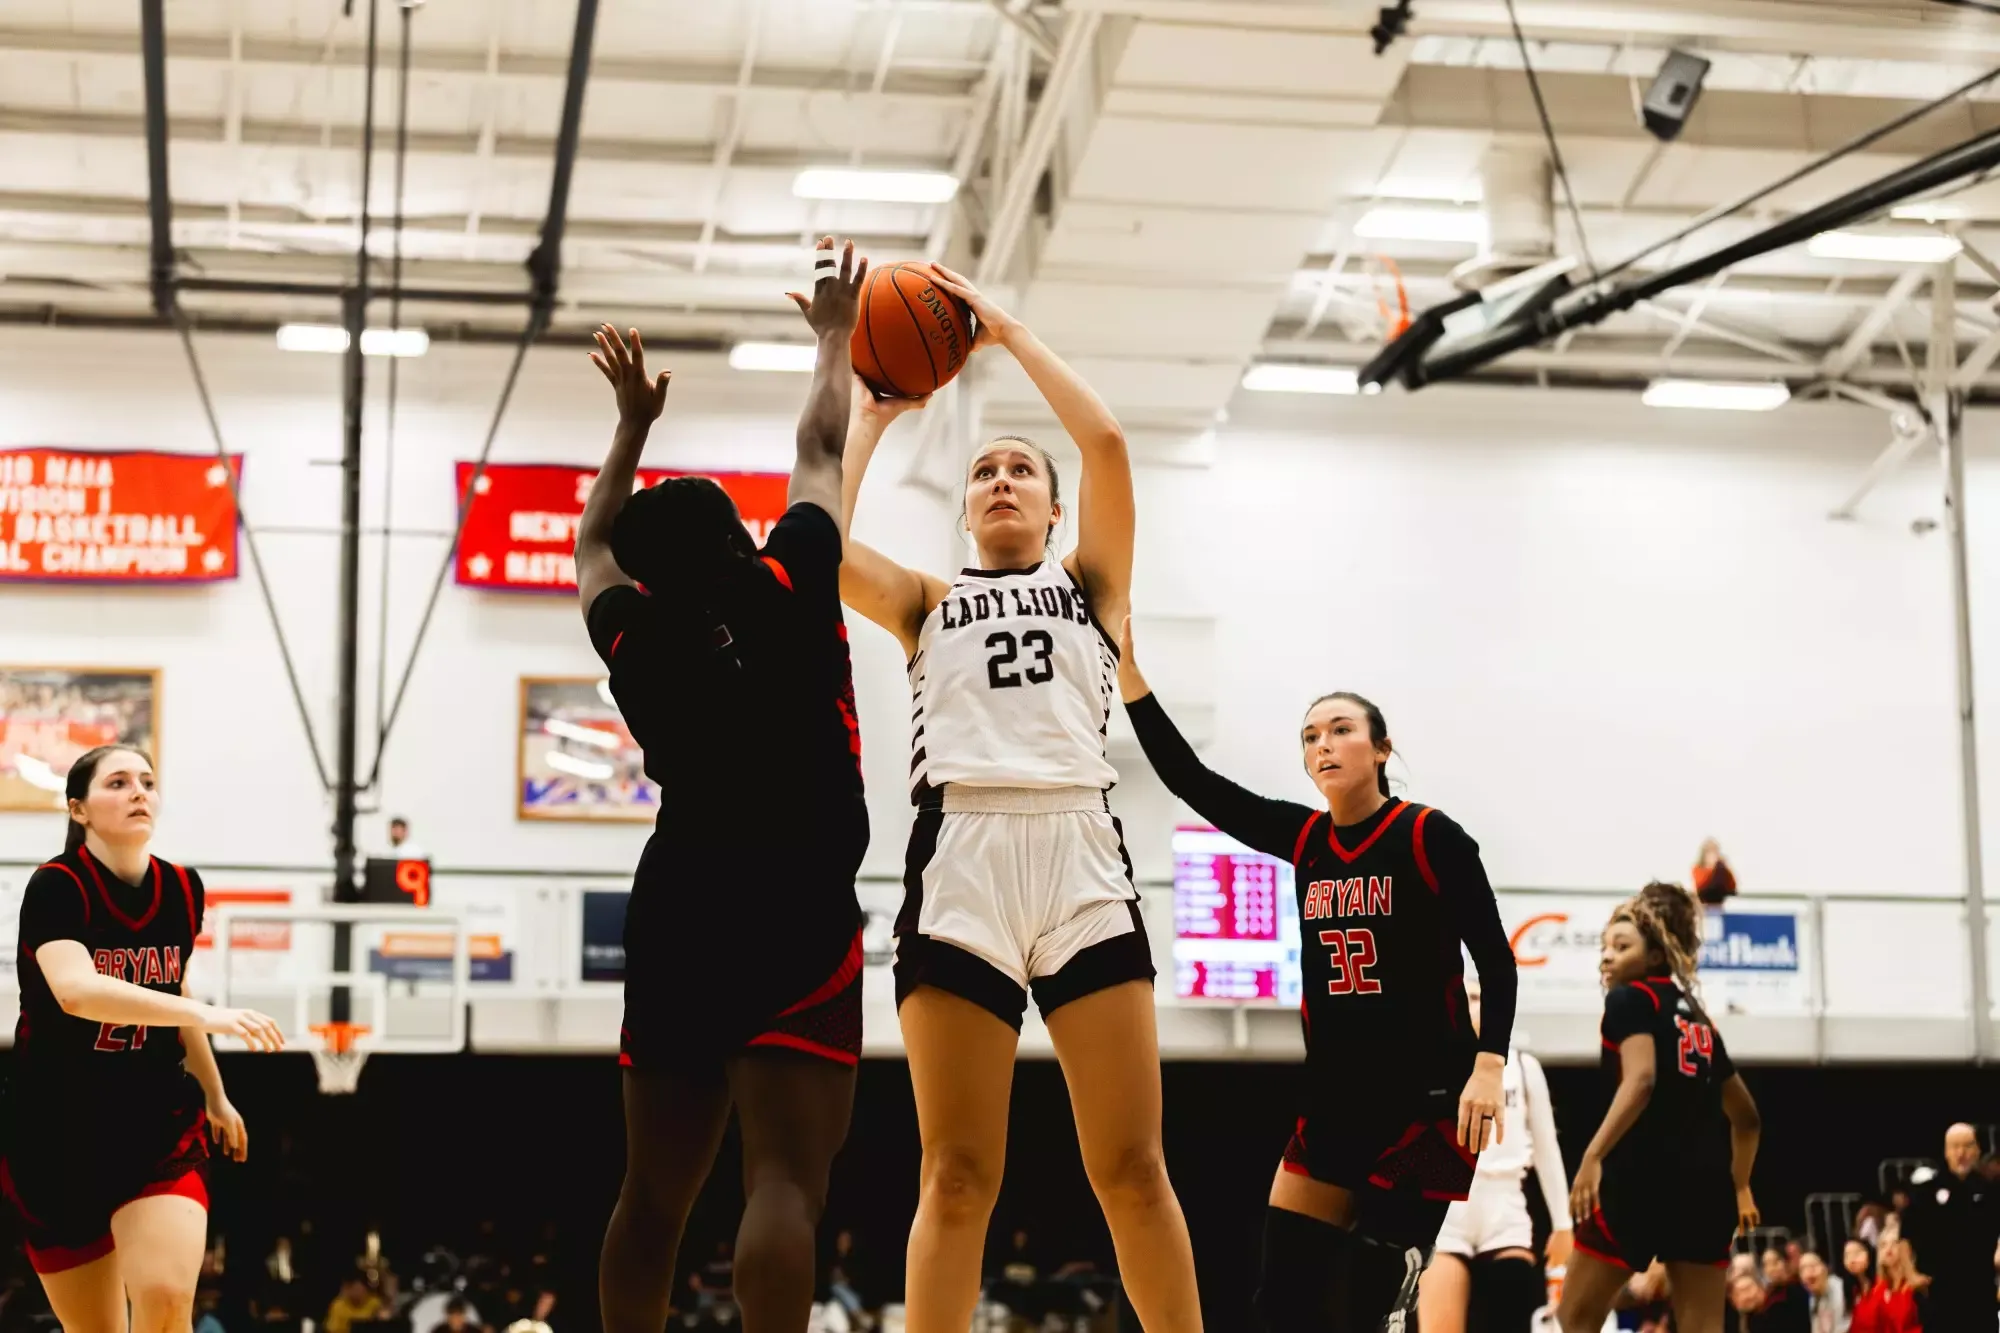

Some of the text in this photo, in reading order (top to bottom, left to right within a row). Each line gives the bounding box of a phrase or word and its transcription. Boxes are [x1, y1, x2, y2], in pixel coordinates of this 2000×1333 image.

[45, 457, 114, 488] NAIA
[15, 512, 205, 547] BASKETBALL
[42, 541, 187, 574] CHAMPION
[941, 585, 1090, 630] LADY LIONS
[985, 630, 1054, 689] 23
[395, 859, 430, 907] 9
[1304, 876, 1392, 920] BRYAN
[94, 946, 180, 984] BRYAN
[1318, 928, 1382, 995] 32
[1673, 1014, 1713, 1076] 24
